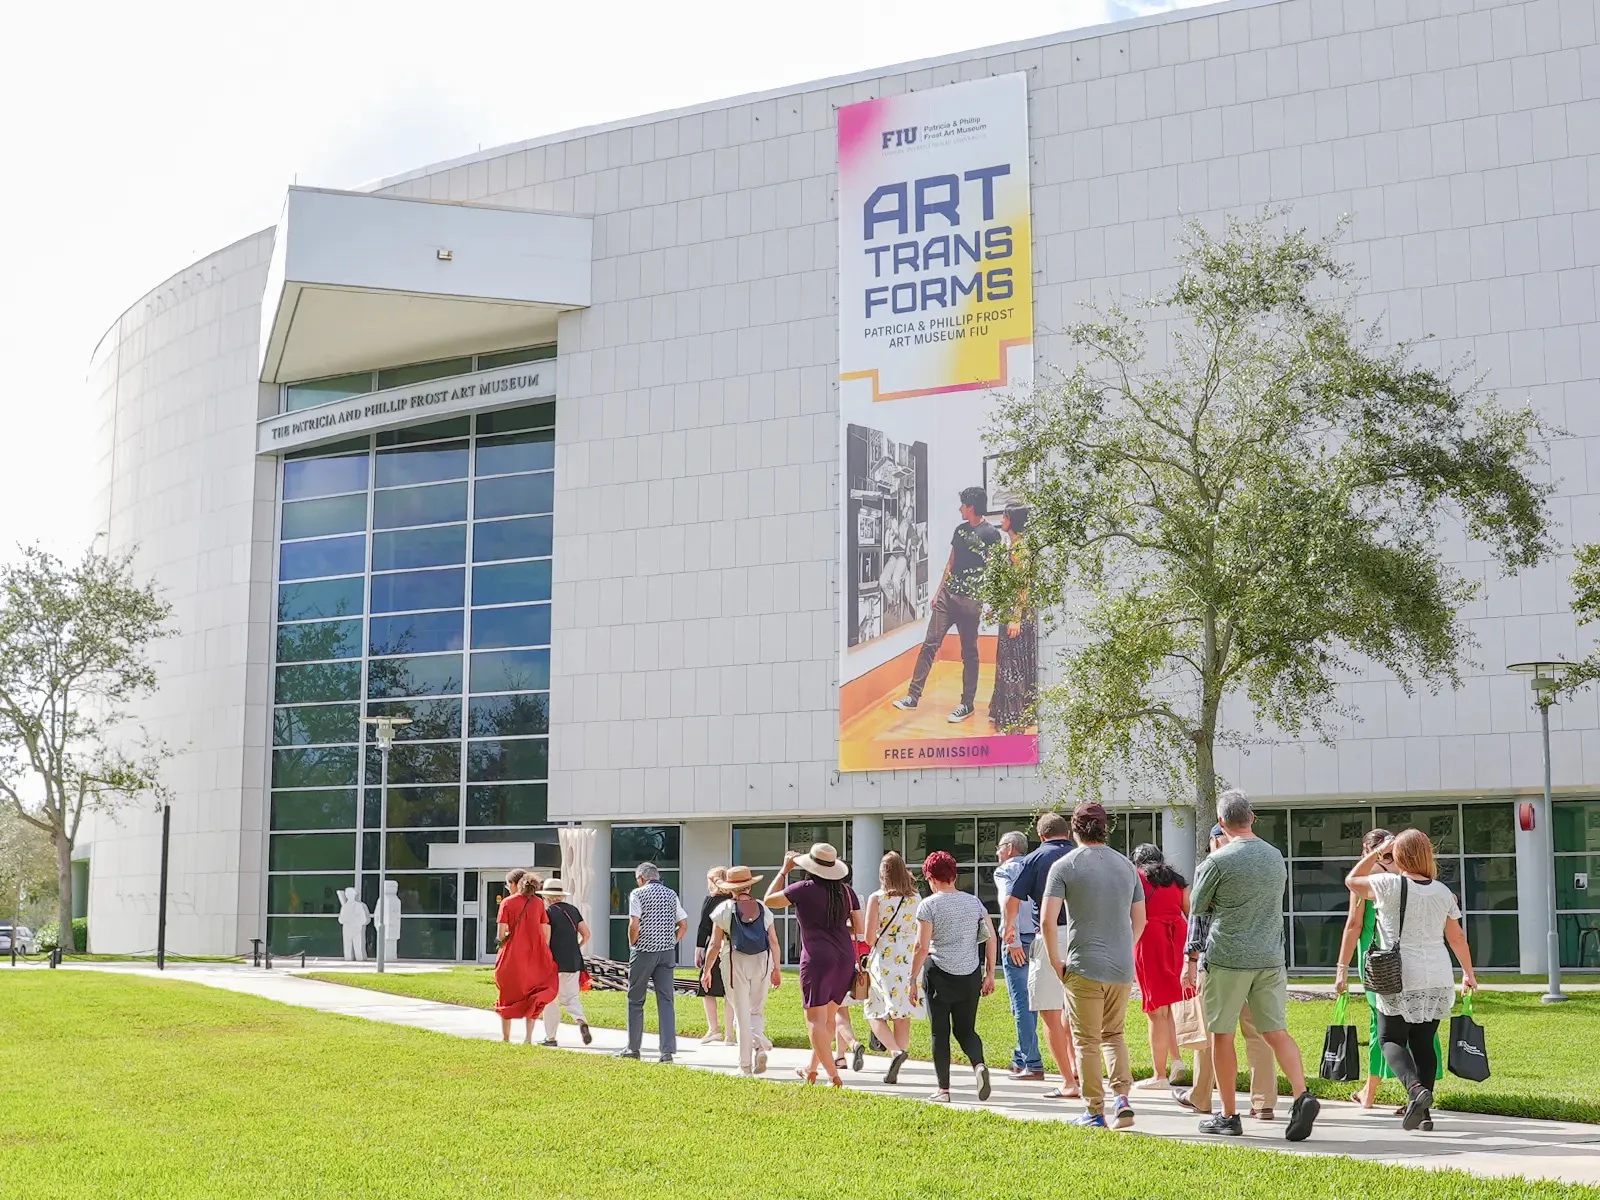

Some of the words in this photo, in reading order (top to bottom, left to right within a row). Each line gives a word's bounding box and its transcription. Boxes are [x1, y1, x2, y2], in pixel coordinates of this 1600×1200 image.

[882, 127, 917, 149] FIU
[924, 121, 950, 132] Patricia
[959, 117, 981, 126] Phillip
[924, 132, 942, 140] Frost
[944, 129, 955, 137] Art
[957, 124, 987, 134] Museum
[864, 164, 1010, 240] ART
[864, 225, 1013, 278] TRANS
[865, 267, 1013, 319] FORMS
[864, 321, 915, 339] PATRICIA
[918, 321, 926, 331] &
[930, 314, 973, 330] PHILLIP
[976, 308, 1014, 323] FROST
[889, 336, 910, 349] ART
[914, 328, 966, 345] MUSEUM
[970, 325, 988, 337] FIU
[271, 425, 290, 440] THE
[292, 414, 337, 434] PATRICIA
[338, 409, 362, 423] AND
[364, 398, 408, 417] PHILLIP
[410, 390, 449, 408] FROST
[451, 385, 477, 400] ART
[480, 374, 540, 396] MUSEUM
[884, 748, 914, 759] FREE
[918, 745, 990, 758] ADMISSION
